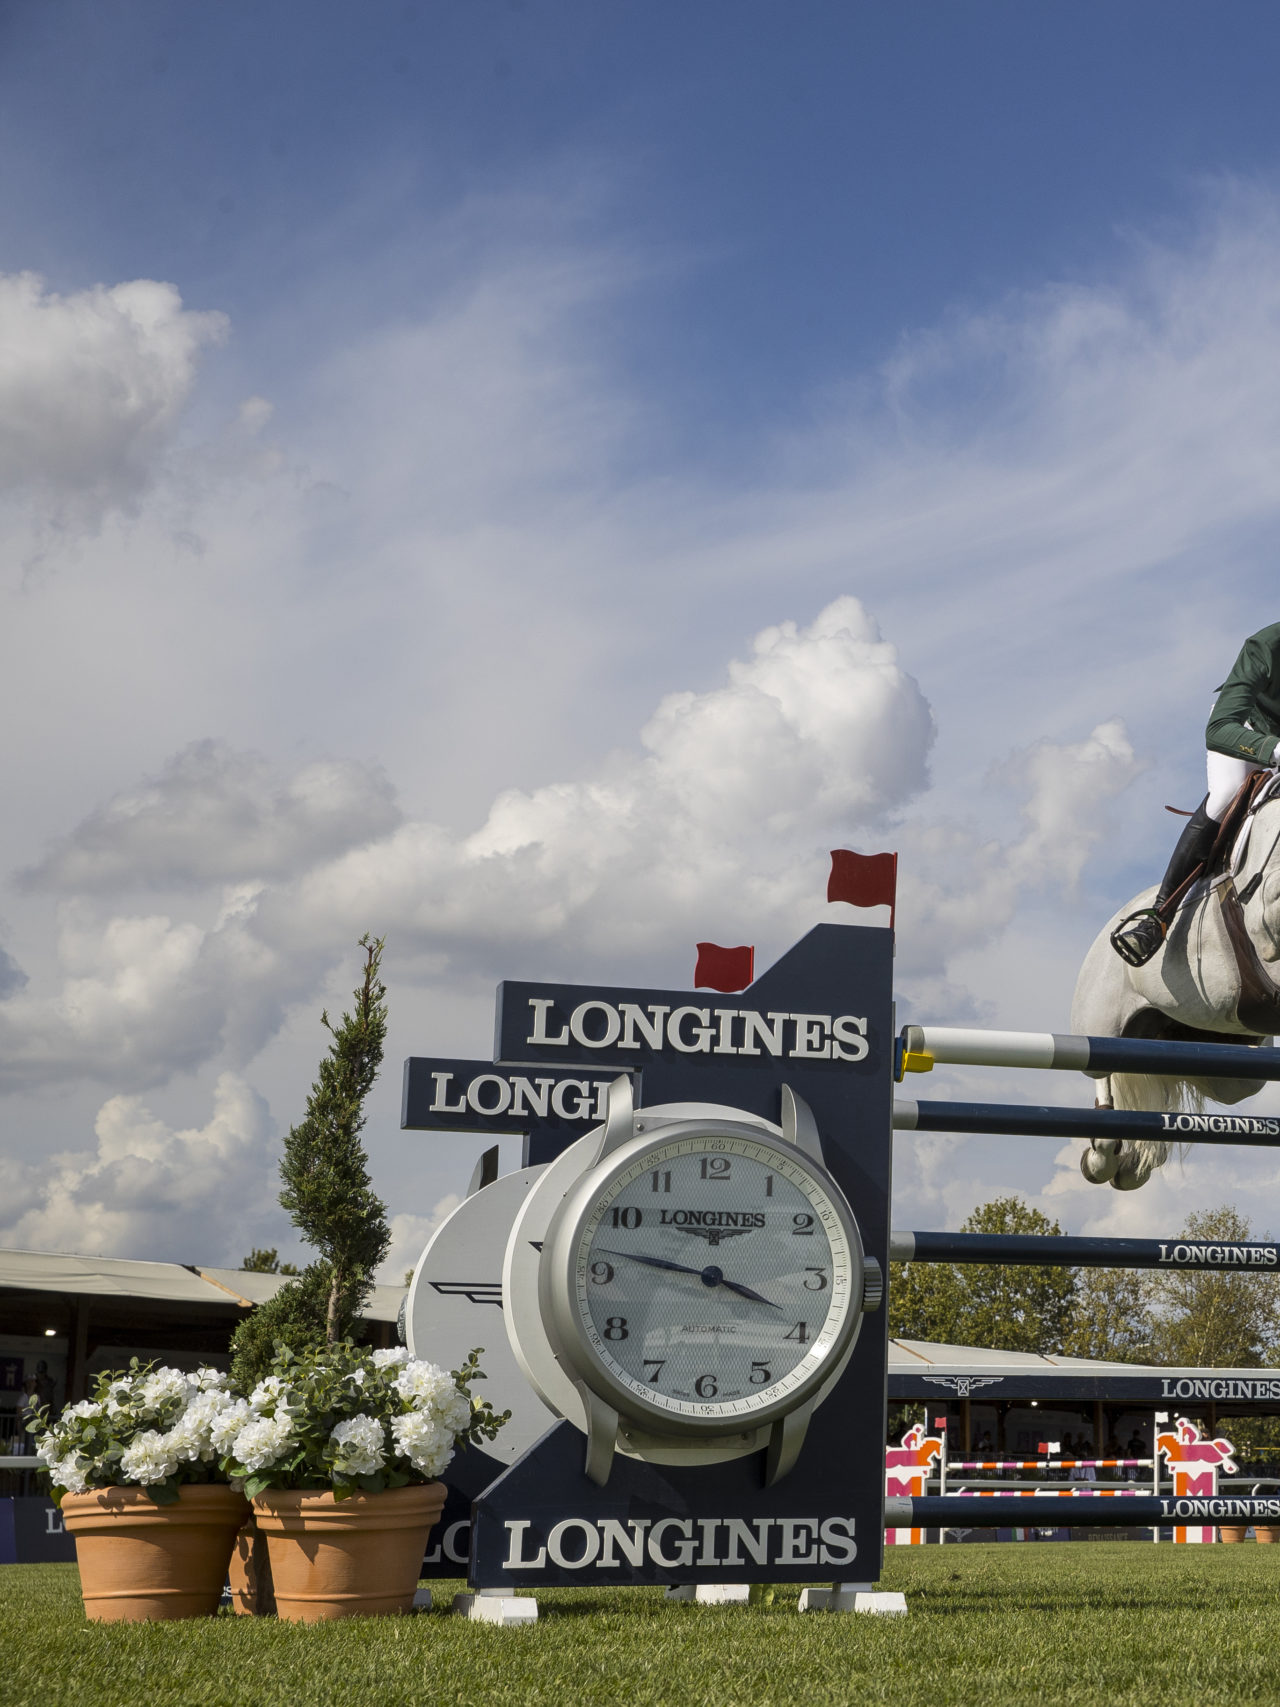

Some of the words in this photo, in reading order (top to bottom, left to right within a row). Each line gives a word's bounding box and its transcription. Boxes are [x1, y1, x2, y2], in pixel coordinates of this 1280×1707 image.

[526, 998, 869, 1062] LONGINES
[429, 1072, 608, 1121] LONGI
[1161, 1114, 1280, 1135] LONGINES
[650, 1170, 672, 1193] 11
[699, 1157, 732, 1181] 12
[764, 1174, 774, 1198] 1
[611, 1206, 643, 1230] 10
[660, 1209, 766, 1228] LONGINES
[791, 1212, 815, 1236] 2
[1159, 1244, 1278, 1265] LONGINES
[590, 1261, 615, 1286] 9
[803, 1267, 828, 1292] 3
[603, 1316, 629, 1341] 8
[682, 1324, 737, 1334] AUTOMATIC
[783, 1320, 811, 1345] 4
[643, 1359, 666, 1384] 7
[749, 1360, 772, 1385] 5
[694, 1374, 719, 1399] 6
[502, 1517, 858, 1570] LONGINES
